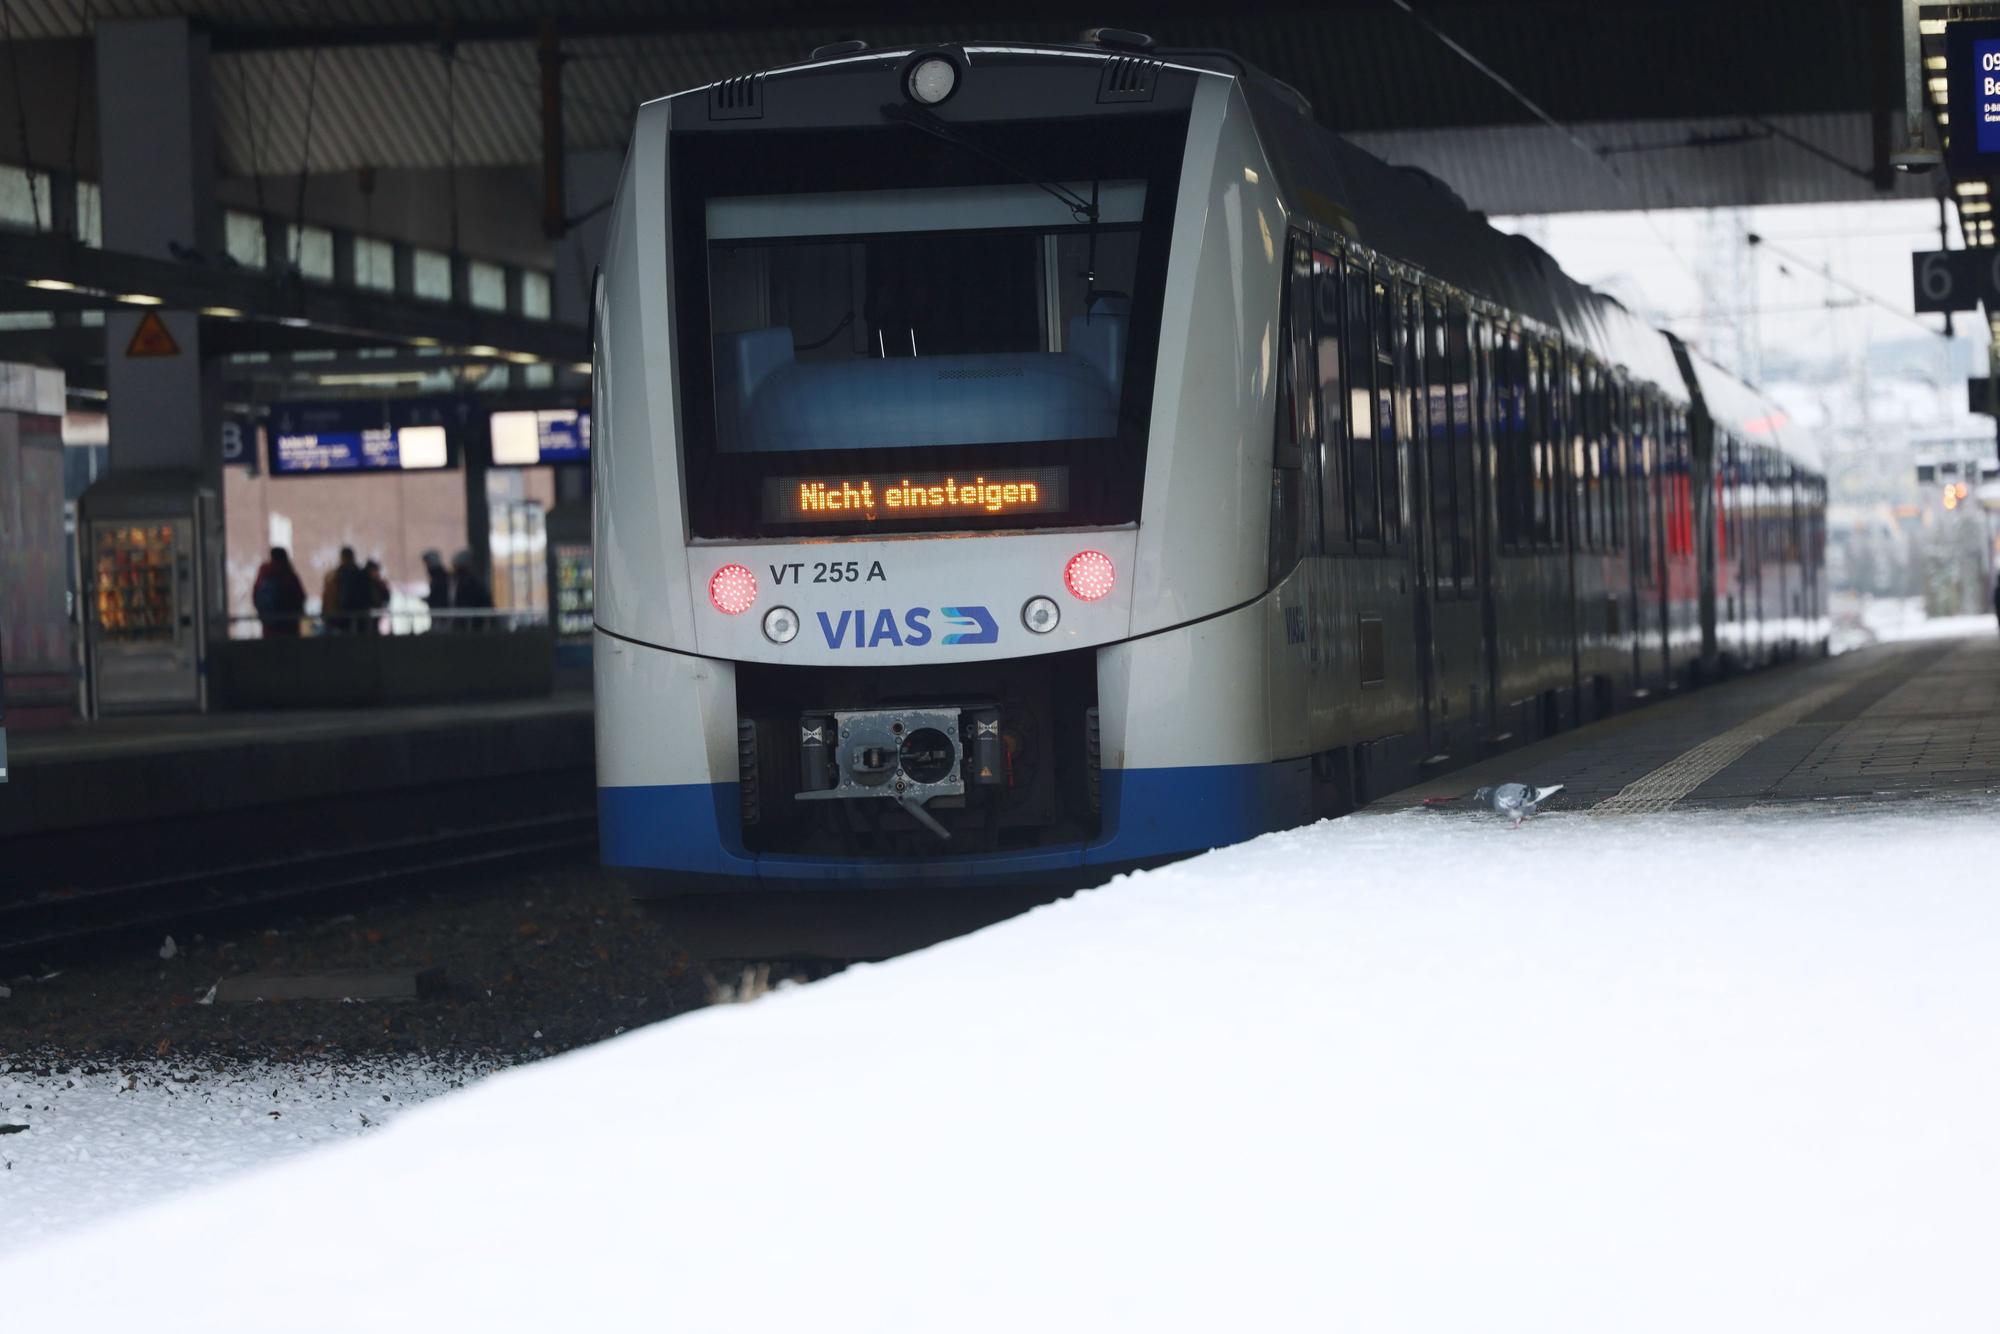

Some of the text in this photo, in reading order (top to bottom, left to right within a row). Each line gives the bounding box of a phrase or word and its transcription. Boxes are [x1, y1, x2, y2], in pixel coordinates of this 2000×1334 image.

[1982, 53, 2000, 71] 09
[1921, 252, 1952, 301] 6
[801, 477, 1037, 510] Nicht einsteigen
[769, 560, 887, 585] VT 255 A
[816, 607, 932, 649] VIAS
